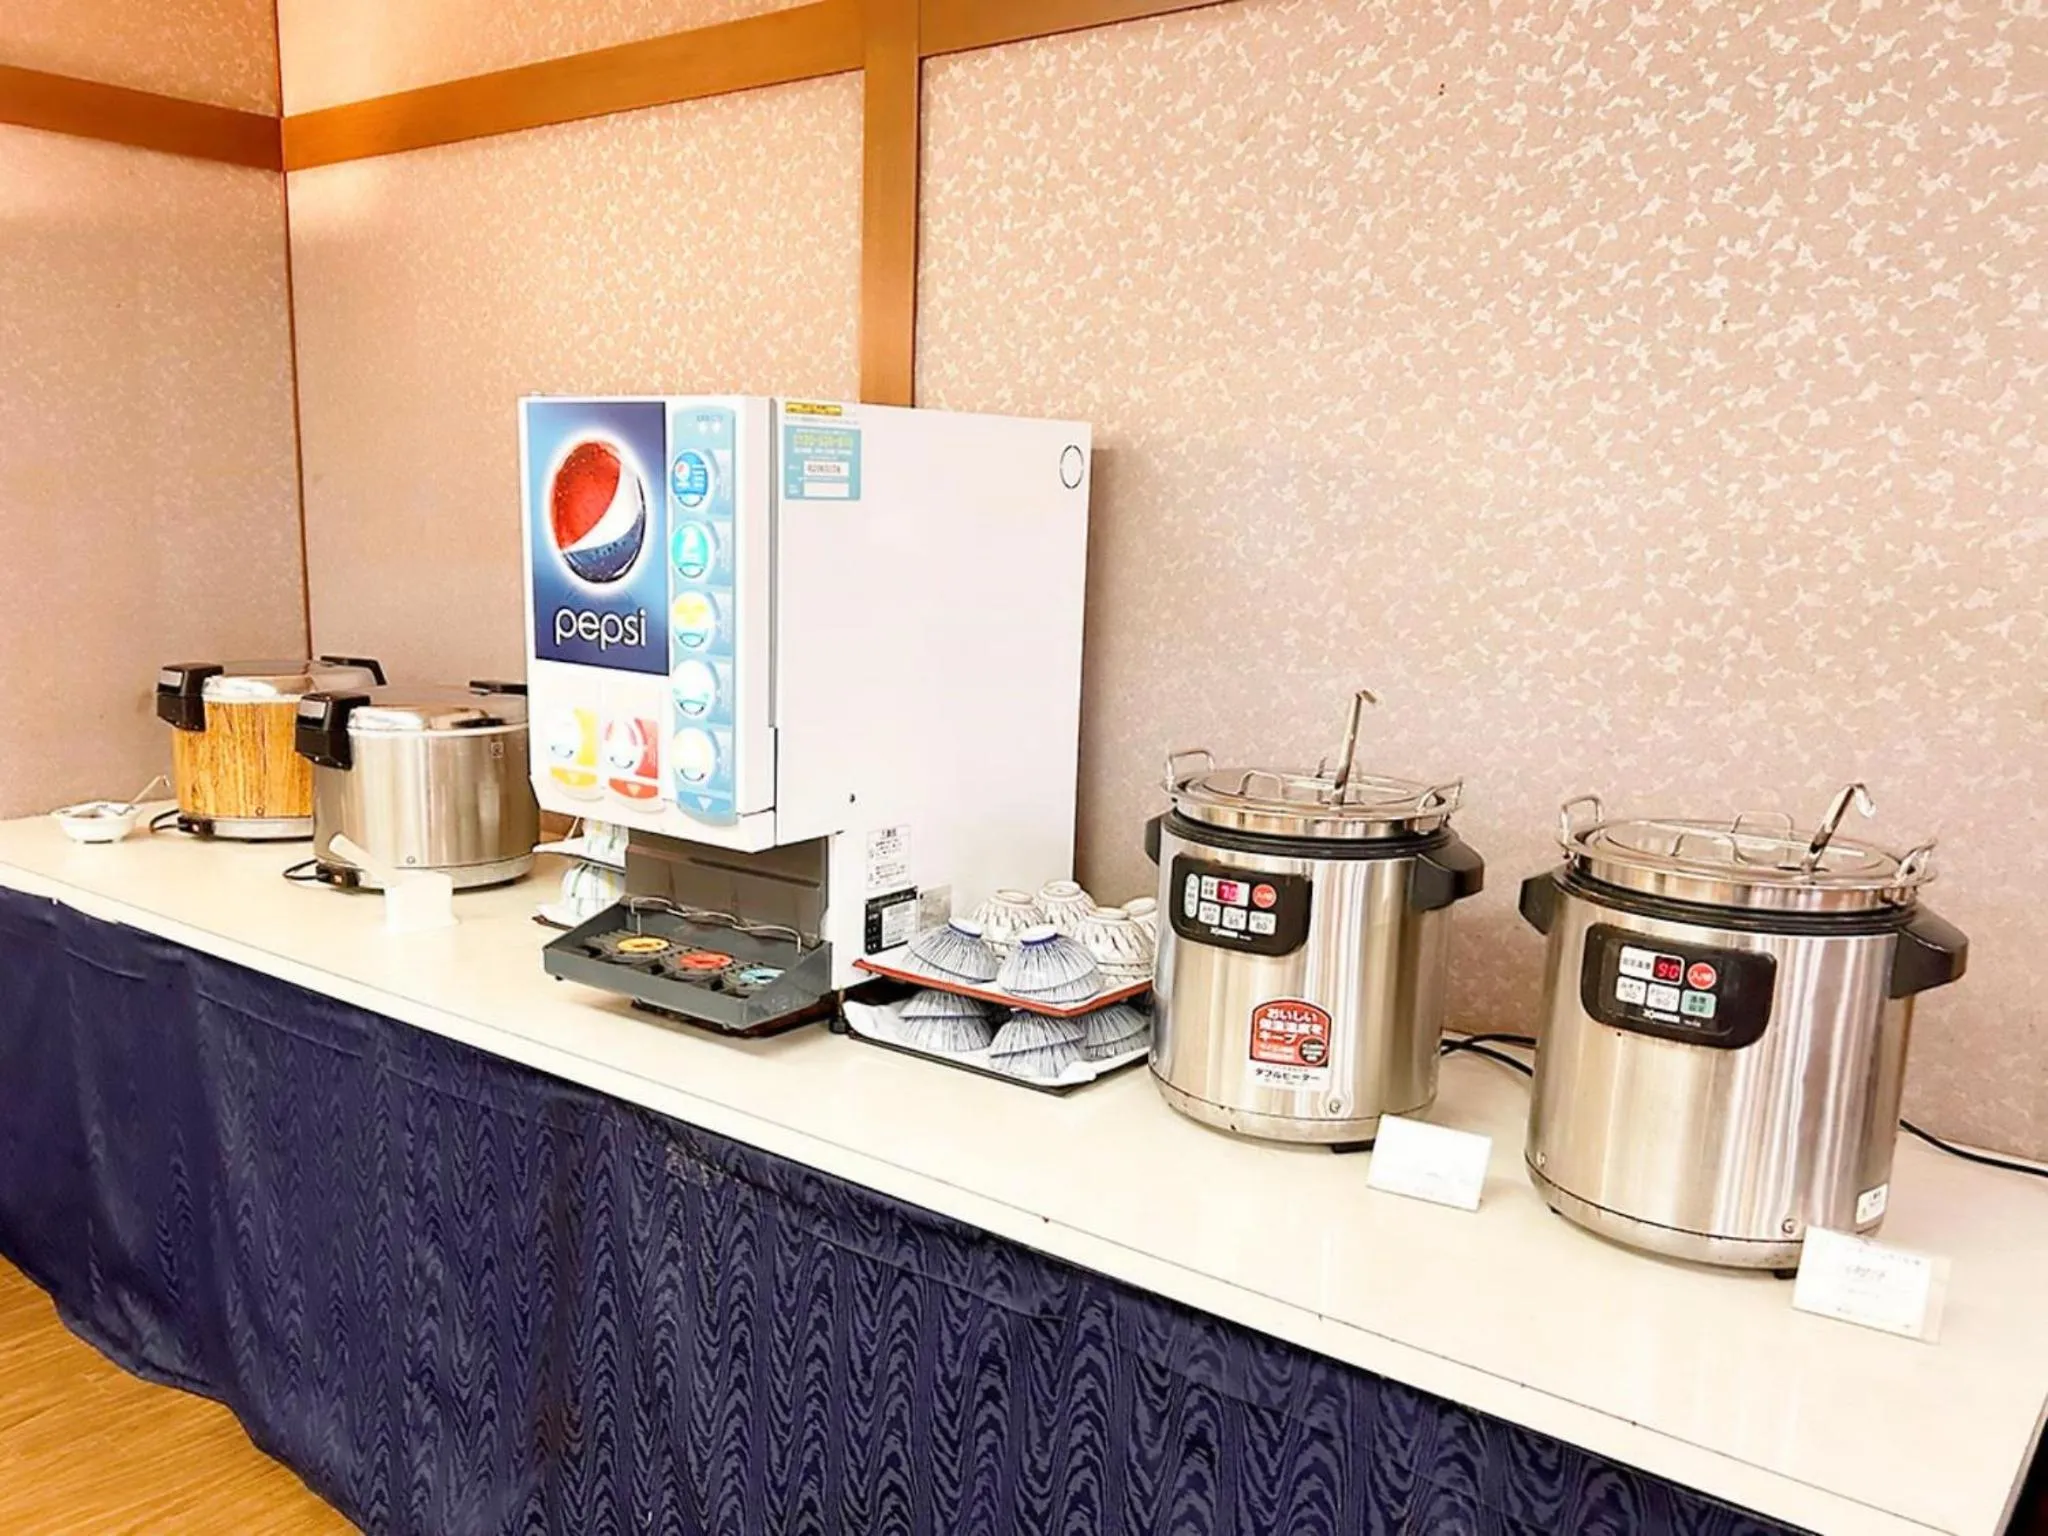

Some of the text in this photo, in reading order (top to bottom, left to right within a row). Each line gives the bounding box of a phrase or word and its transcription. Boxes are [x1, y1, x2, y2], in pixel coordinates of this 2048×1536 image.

[554, 607, 647, 652] pepsi
[1658, 962, 1680, 979] 90
[1267, 1008, 1318, 1023] おいしい
